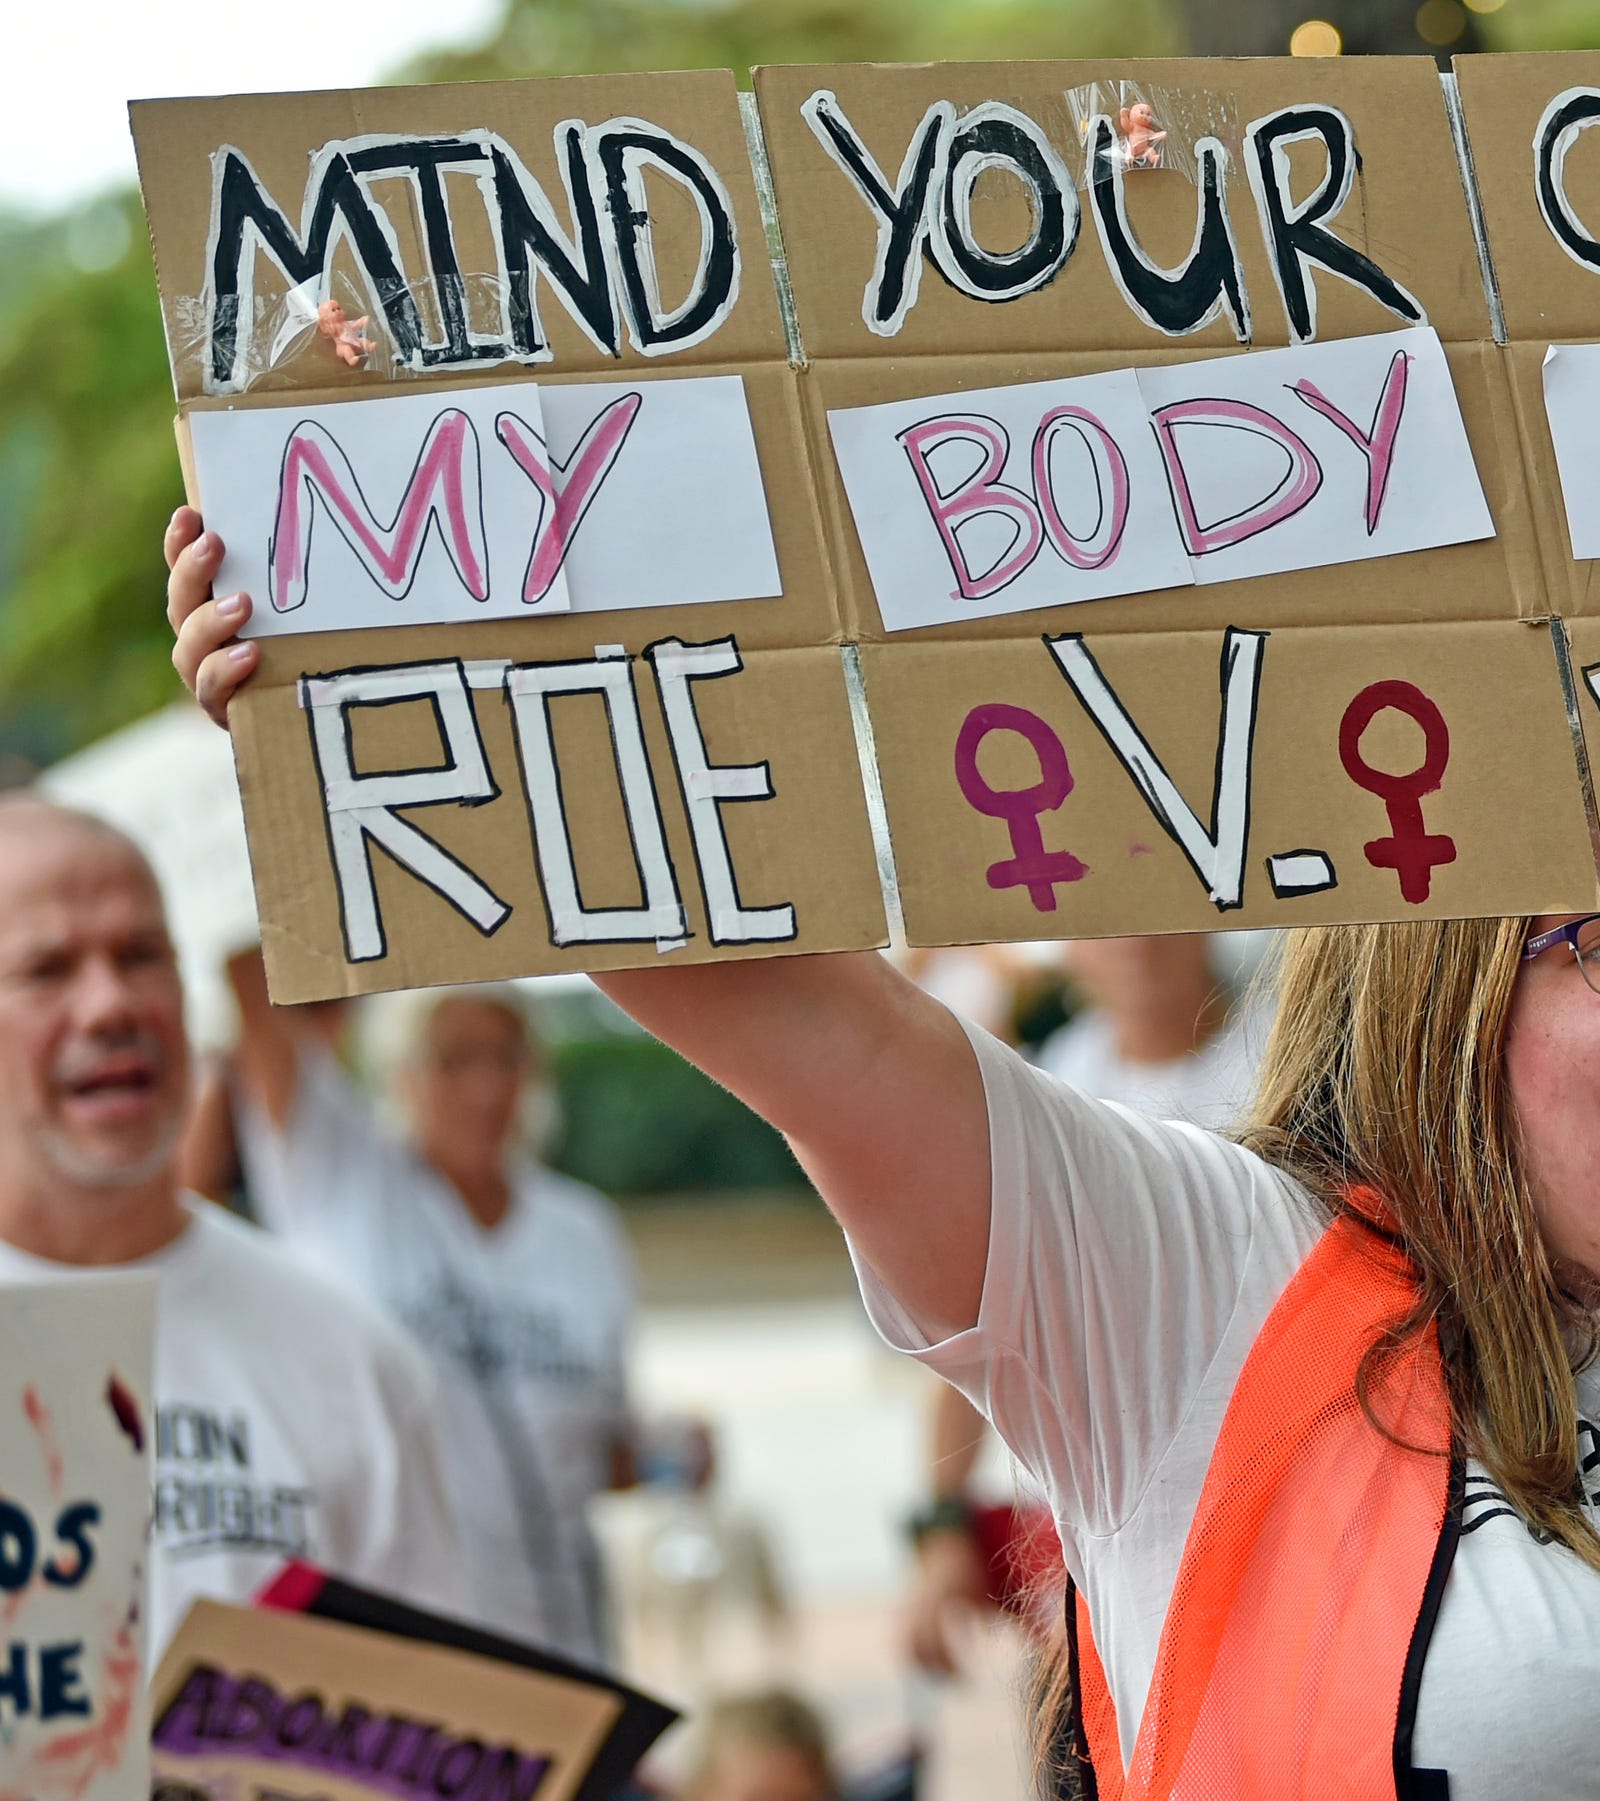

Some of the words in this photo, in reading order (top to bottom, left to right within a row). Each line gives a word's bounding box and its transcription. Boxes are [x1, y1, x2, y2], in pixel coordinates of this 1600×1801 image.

[203, 116, 741, 394] MIND
[800, 89, 1428, 345] YOUR
[269, 391, 642, 613] MY
[895, 349, 1415, 600] BODY
[296, 634, 798, 963] ROE
